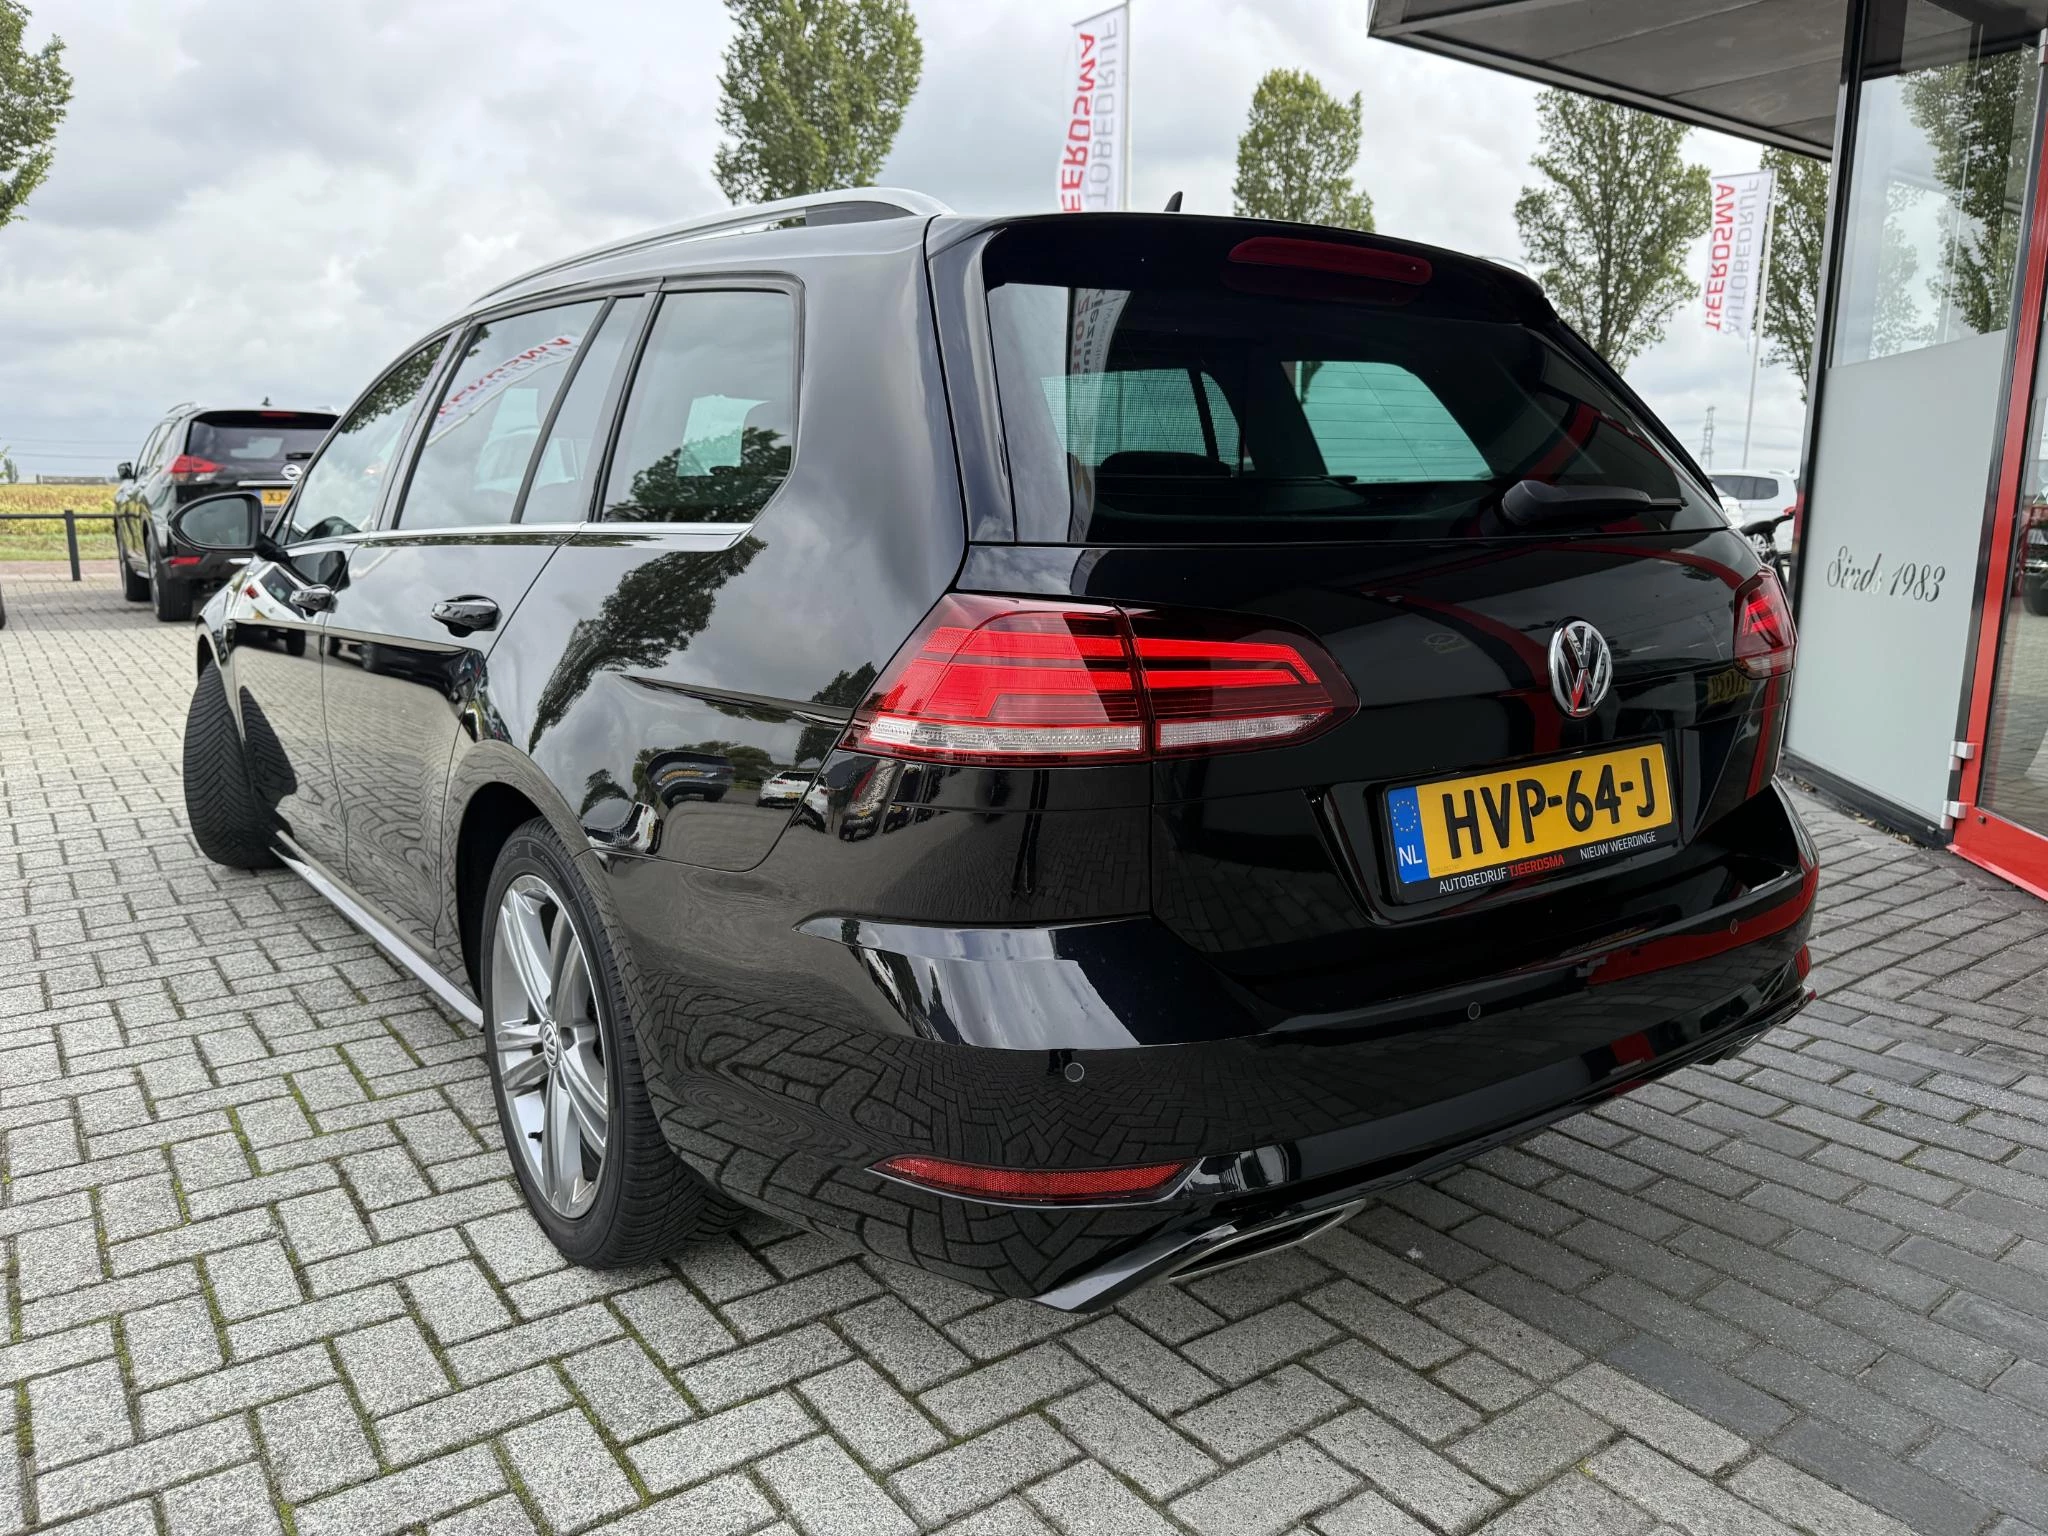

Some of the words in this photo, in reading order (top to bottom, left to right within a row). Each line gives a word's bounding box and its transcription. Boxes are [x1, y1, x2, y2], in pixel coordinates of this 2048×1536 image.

[1889, 562, 1946, 602] 1983
[1441, 757, 1656, 860] HVP-64-J
[1399, 845, 1423, 867] NL
[1439, 867, 1507, 894] AUTOBEDRIJF
[1507, 854, 1565, 878] TJEERDSMA
[1580, 842, 1610, 861] NIEUW
[1610, 831, 1657, 852] WEERDINGE
